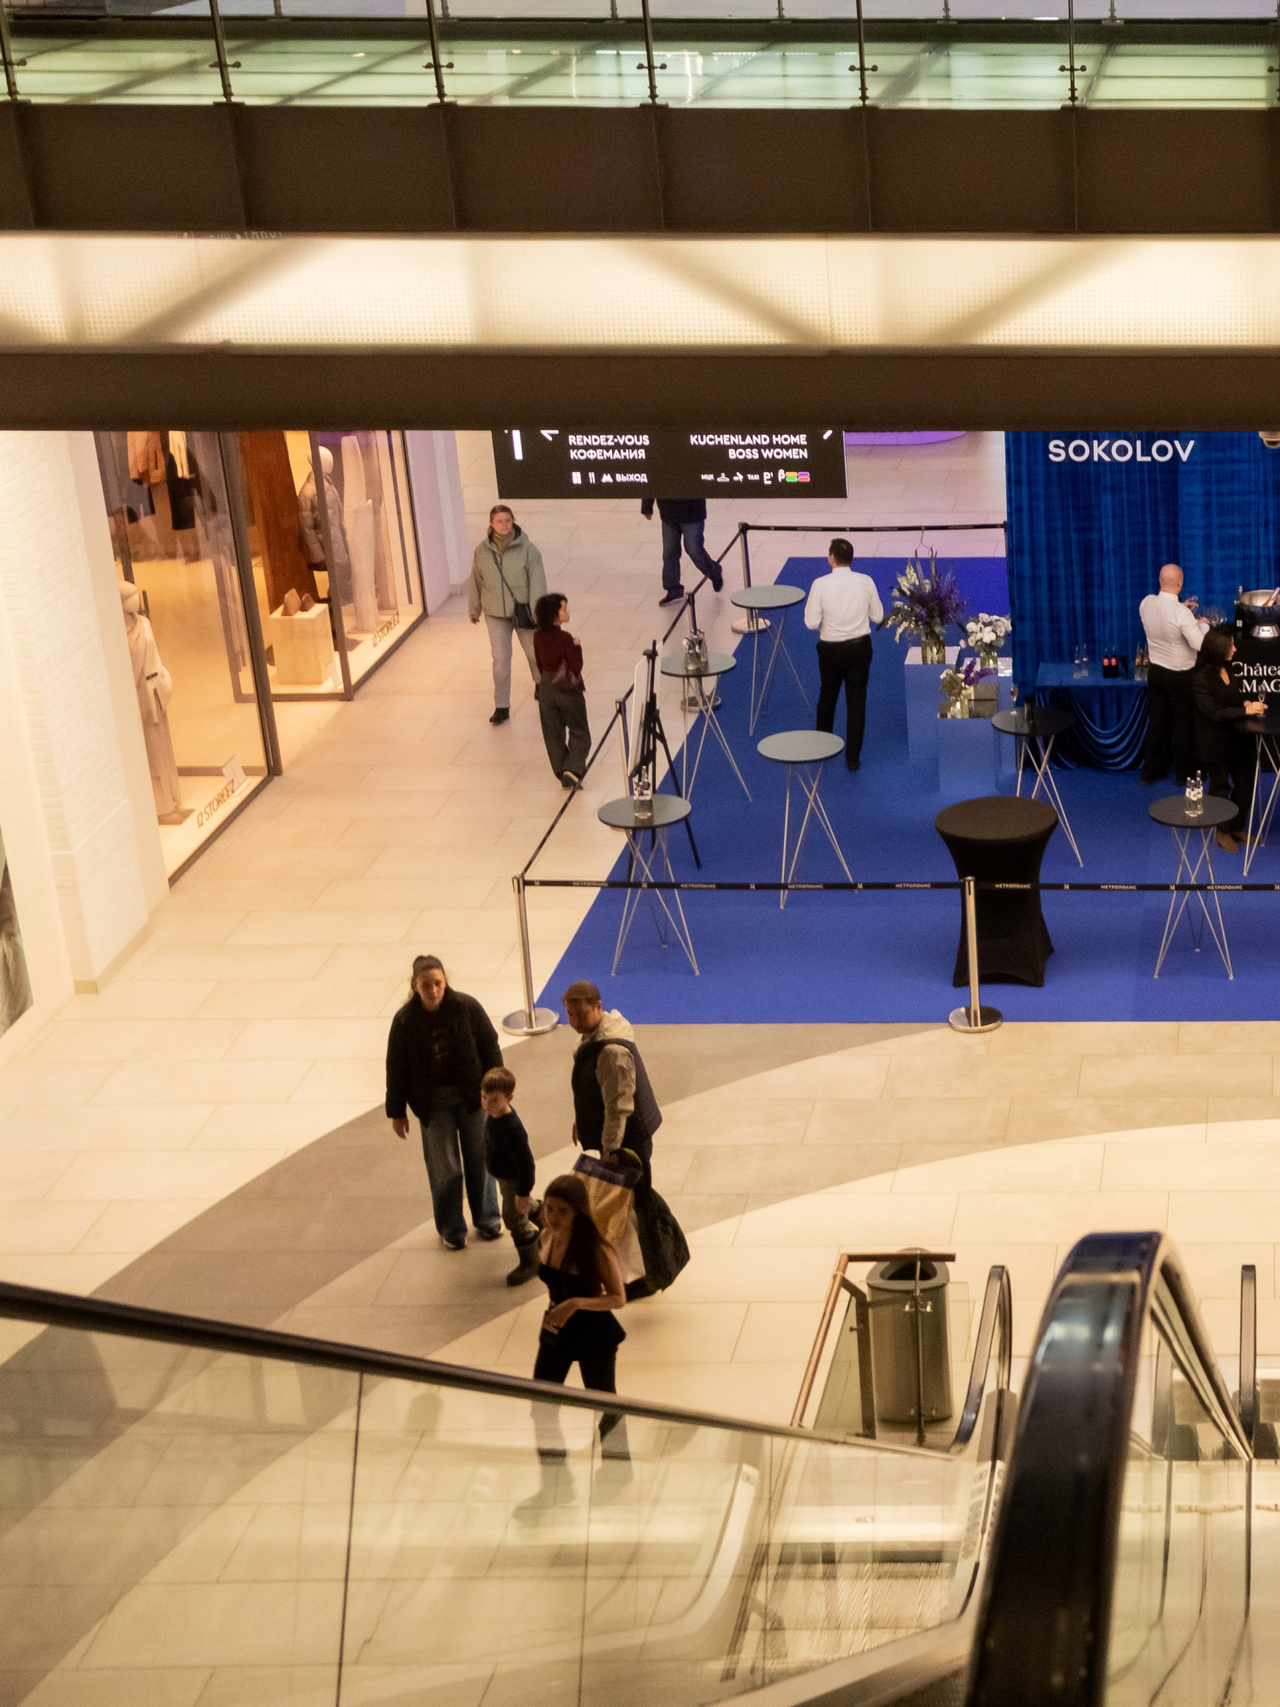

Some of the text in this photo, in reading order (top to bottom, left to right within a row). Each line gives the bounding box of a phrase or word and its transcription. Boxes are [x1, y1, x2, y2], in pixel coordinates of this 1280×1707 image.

[568, 435, 650, 446] RENDEZ-VOUS
[690, 434, 808, 446] KUCHENLAND HOME
[569, 449, 646, 460] КОФЕМАНИЯ
[728, 448, 808, 460] BOSS WOMEN
[1048, 439, 1195, 463] SOKOLOV
[615, 473, 648, 483] ВЫХОД
